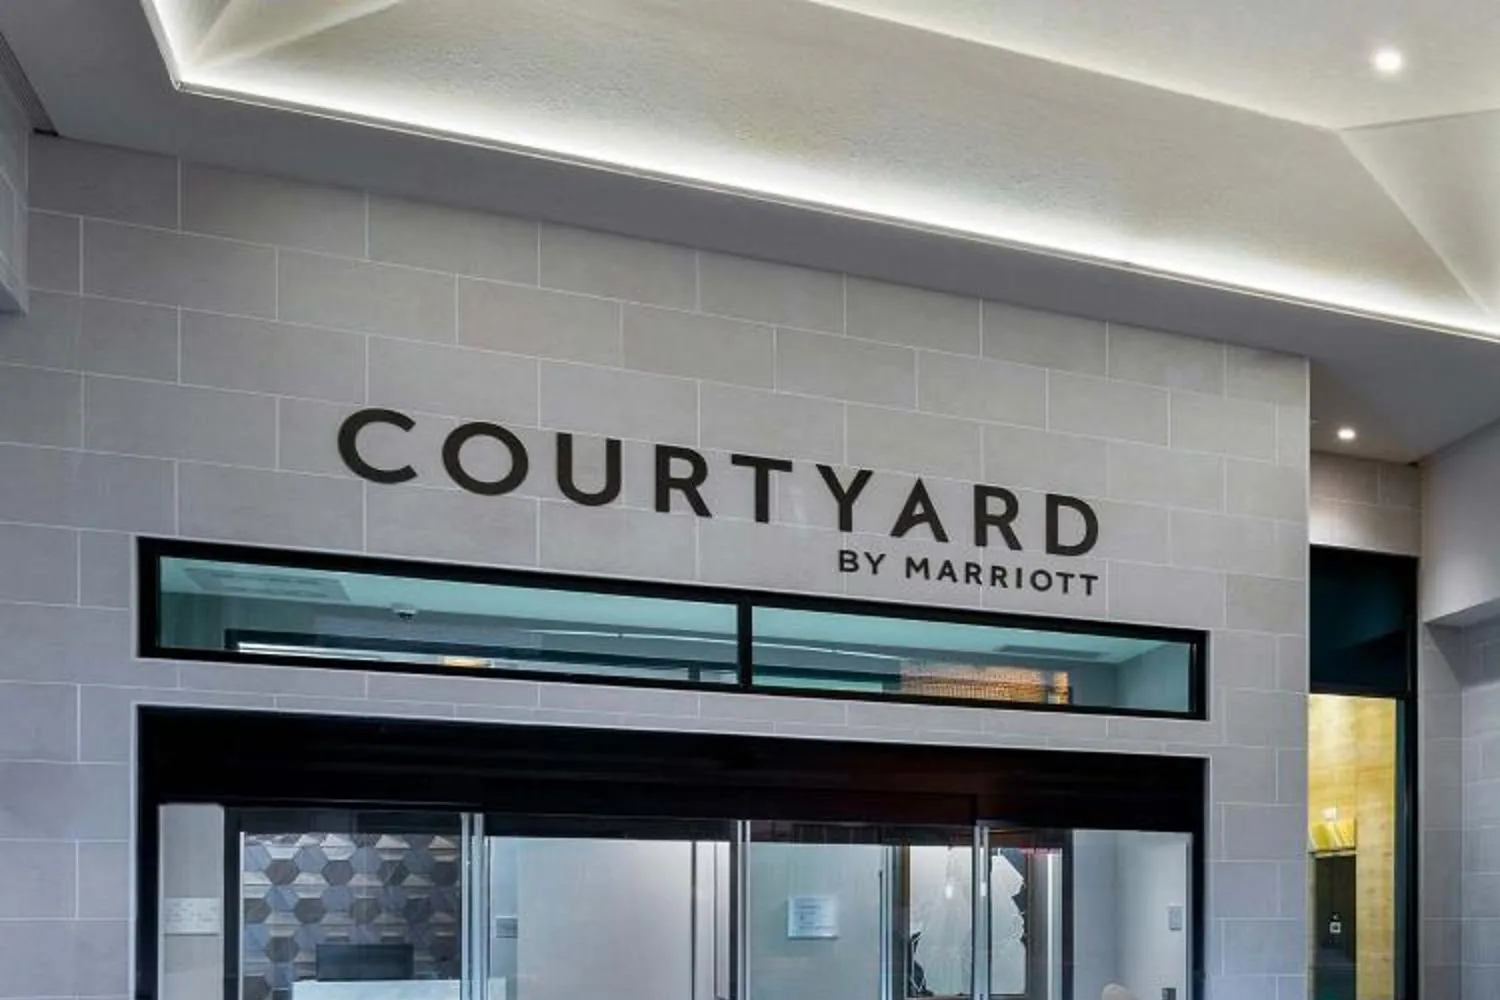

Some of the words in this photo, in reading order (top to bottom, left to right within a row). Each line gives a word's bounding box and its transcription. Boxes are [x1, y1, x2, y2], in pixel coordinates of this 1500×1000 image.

[337, 408, 1099, 557] COURTYARD
[838, 549, 884, 574] BY
[905, 556, 1100, 597] MARRIOTT
